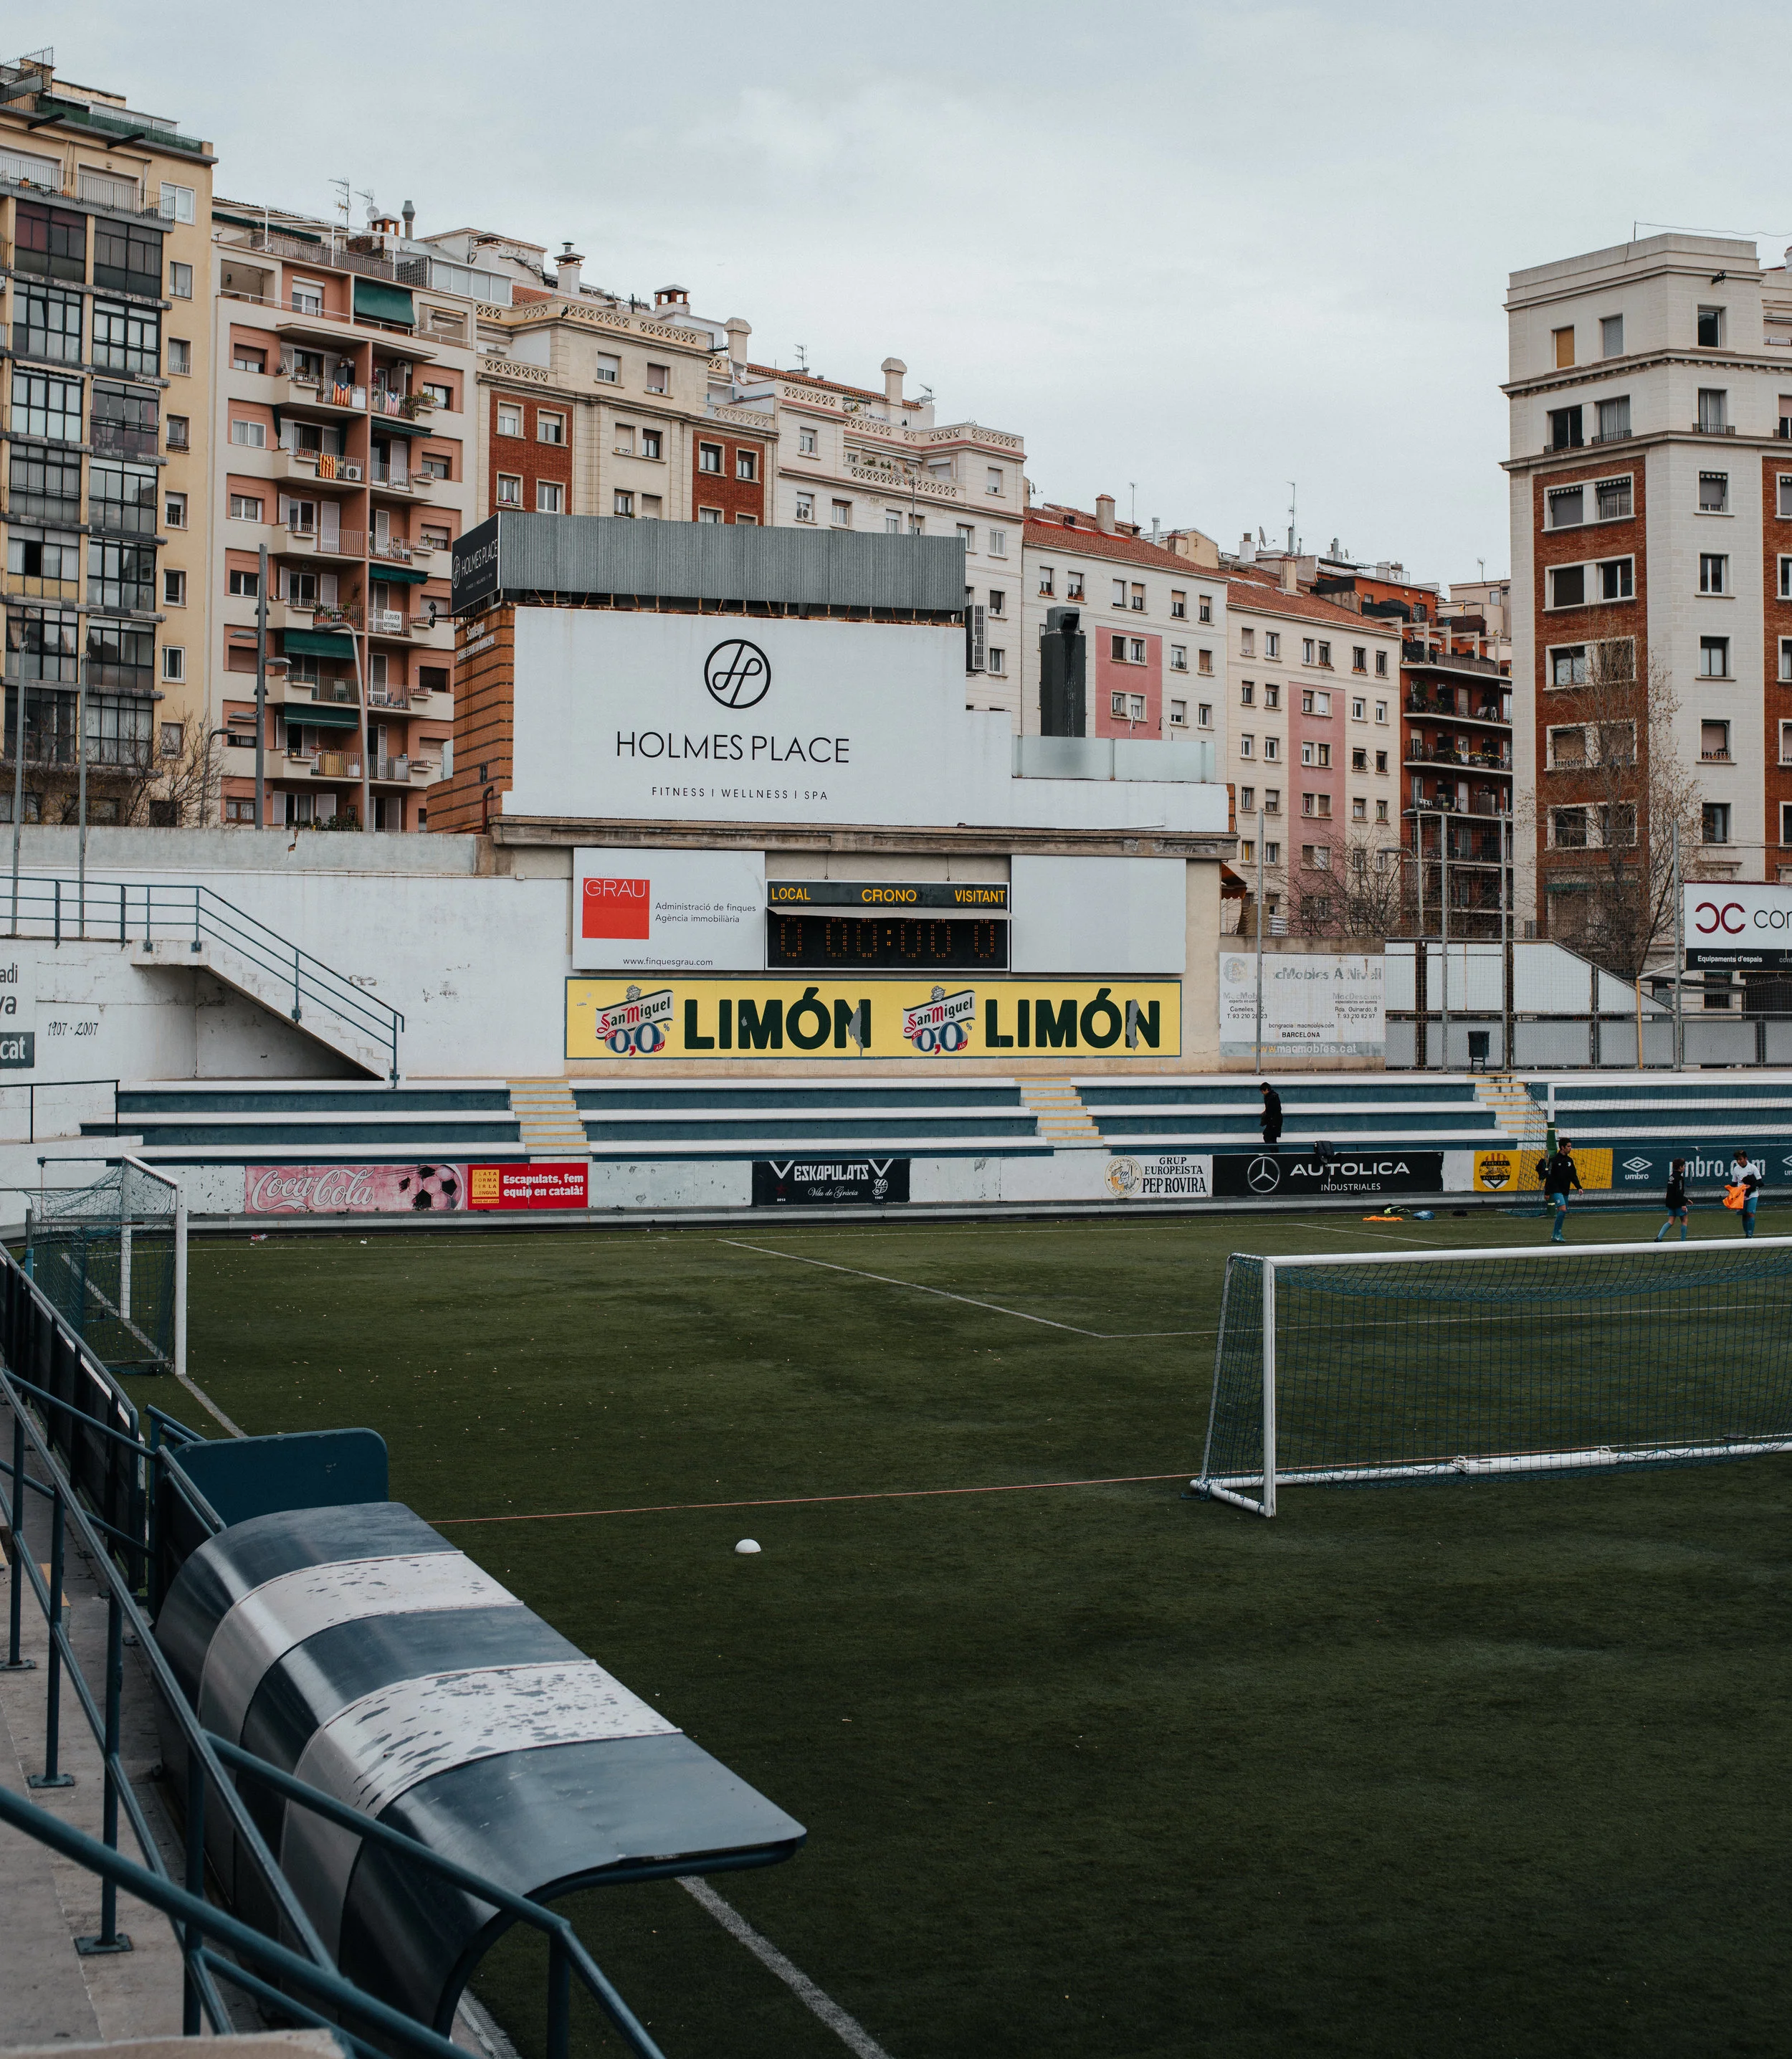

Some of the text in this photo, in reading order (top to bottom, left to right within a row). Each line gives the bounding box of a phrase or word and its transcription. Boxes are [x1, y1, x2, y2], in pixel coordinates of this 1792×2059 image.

[461, 538, 497, 577] HOLMES PLACE
[617, 731, 849, 764] HOLMES PLACE
[652, 786, 827, 800] FITNESS WELLNESS SPA
[585, 880, 646, 898] GRAU
[771, 888, 1006, 903] LOCAL CRONO VISITANT
[655, 901, 711, 911] Administració
[726, 903, 756, 915] finques
[655, 913, 740, 923] Agència immobiliària
[622, 957, 713, 966] www.finquesgrau.com
[1697, 955, 1736, 964] Equipaments
[1738, 955, 1763, 964] d'espais
[1334, 967, 1344, 980] A
[596, 996, 670, 1034] San Miguel
[685, 986, 872, 1050] LIMÓN
[904, 997, 973, 1033] San Miguel
[985, 987, 1160, 1049] LIMÓN
[48, 1021, 99, 1036] 1907 2007
[912, 1030, 922, 1038] SIN
[1159, 1156, 1187, 1165] GRUP
[793, 1164, 869, 1181] ESKAPULATS
[1144, 1166, 1204, 1175] EUROPEISTA
[1290, 1161, 1410, 1176] AUTOLICA
[503, 1173, 584, 1184] Escapulats, fem
[1141, 1177, 1207, 1193] PEP ROVIRA
[251, 1168, 375, 1212] Coca-Cola
[503, 1187, 533, 1199] equip
[548, 1185, 583, 1197] català!
[1321, 1183, 1381, 1192] INDUSTRIALES
